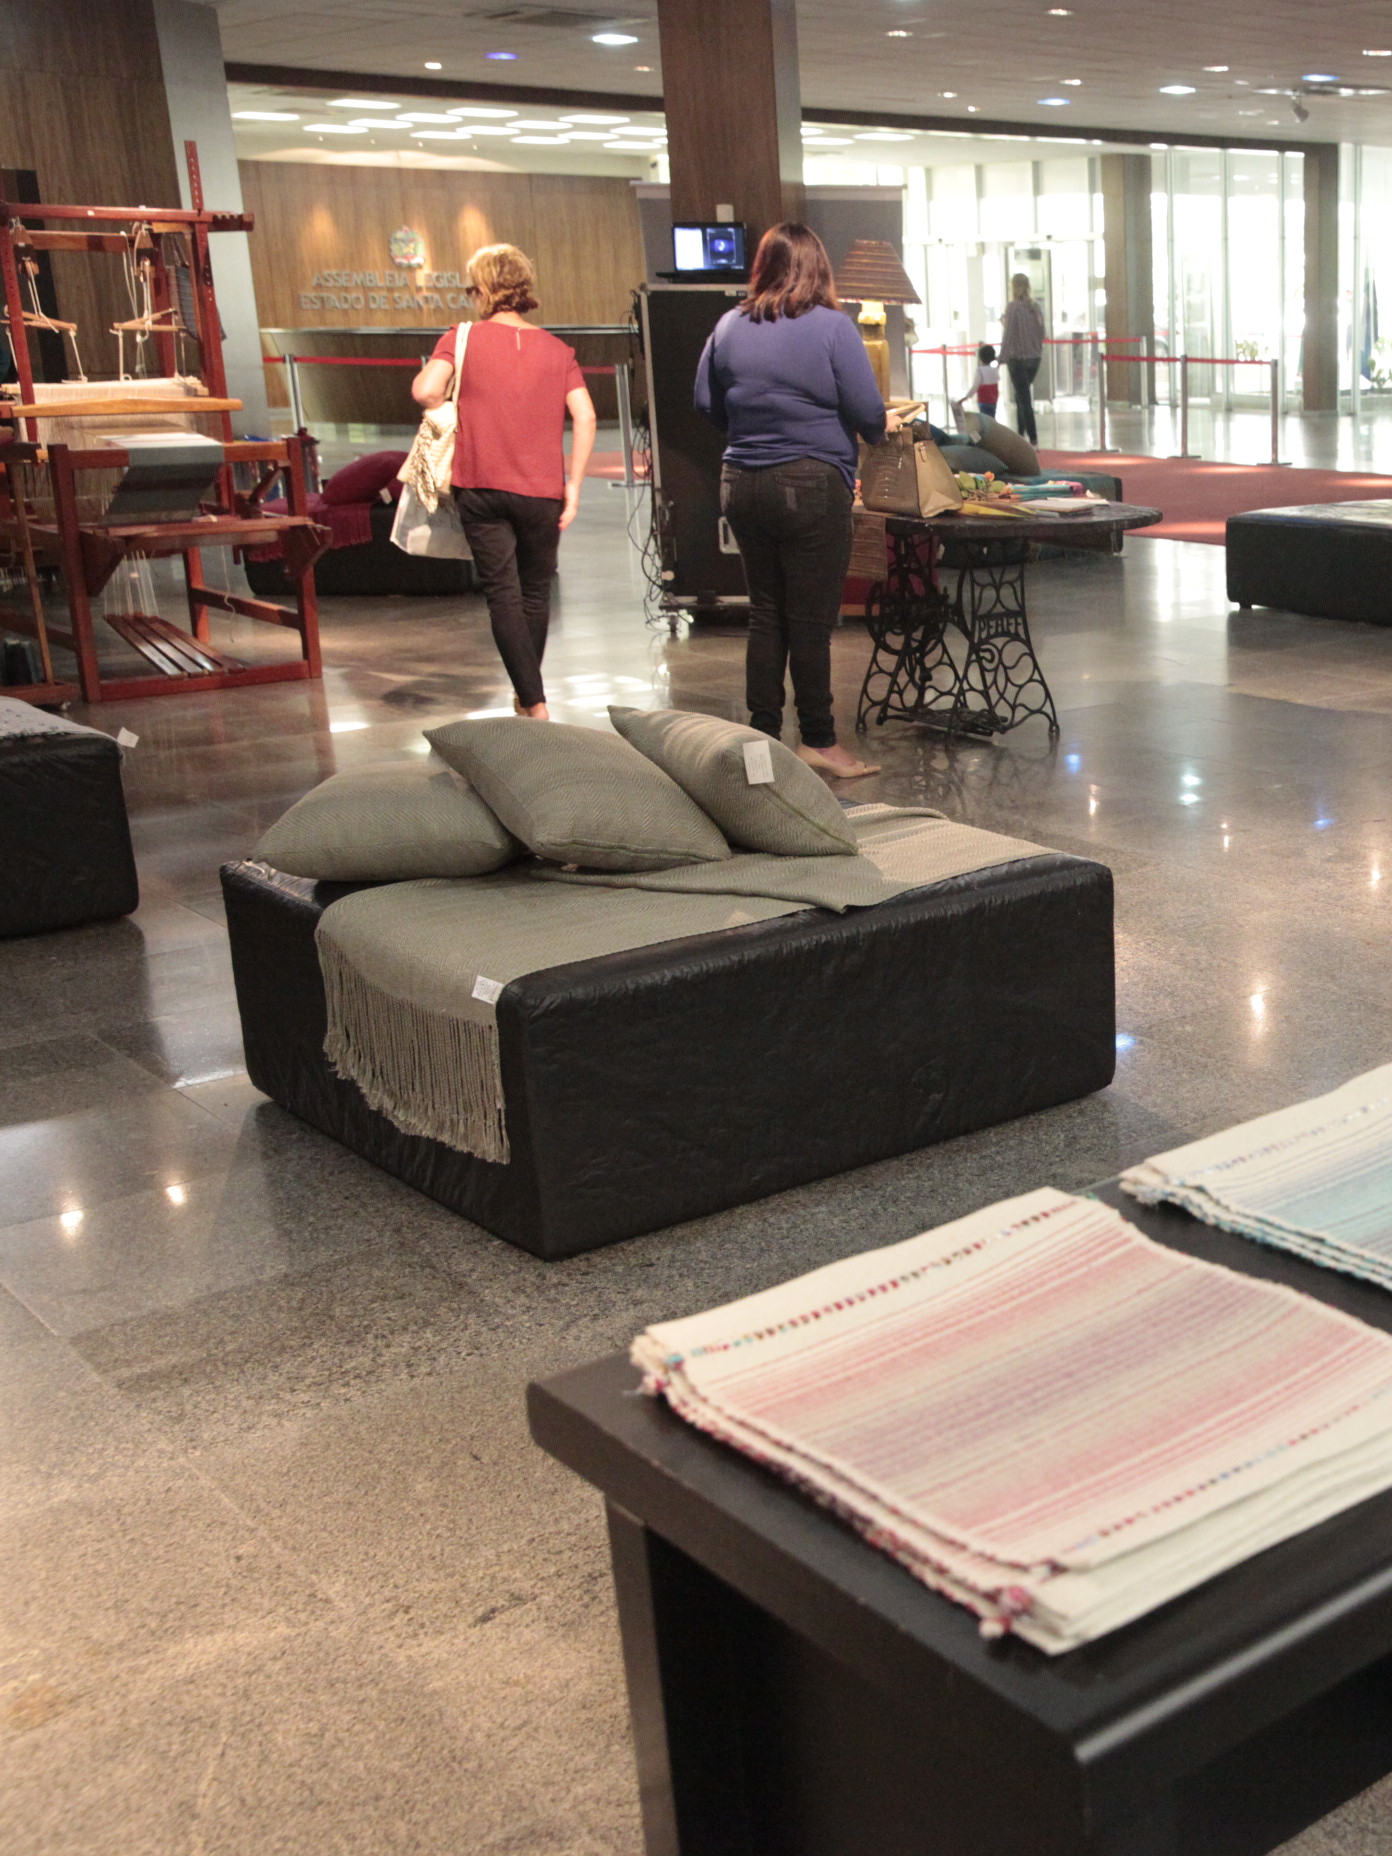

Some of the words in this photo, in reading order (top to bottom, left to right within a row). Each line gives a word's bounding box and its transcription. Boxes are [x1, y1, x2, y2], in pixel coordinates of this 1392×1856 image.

[312, 271, 409, 288] ASSEMBLEIA
[301, 293, 364, 310] ESTADO
[369, 293, 390, 310] DE
[394, 293, 443, 309] SANTA
